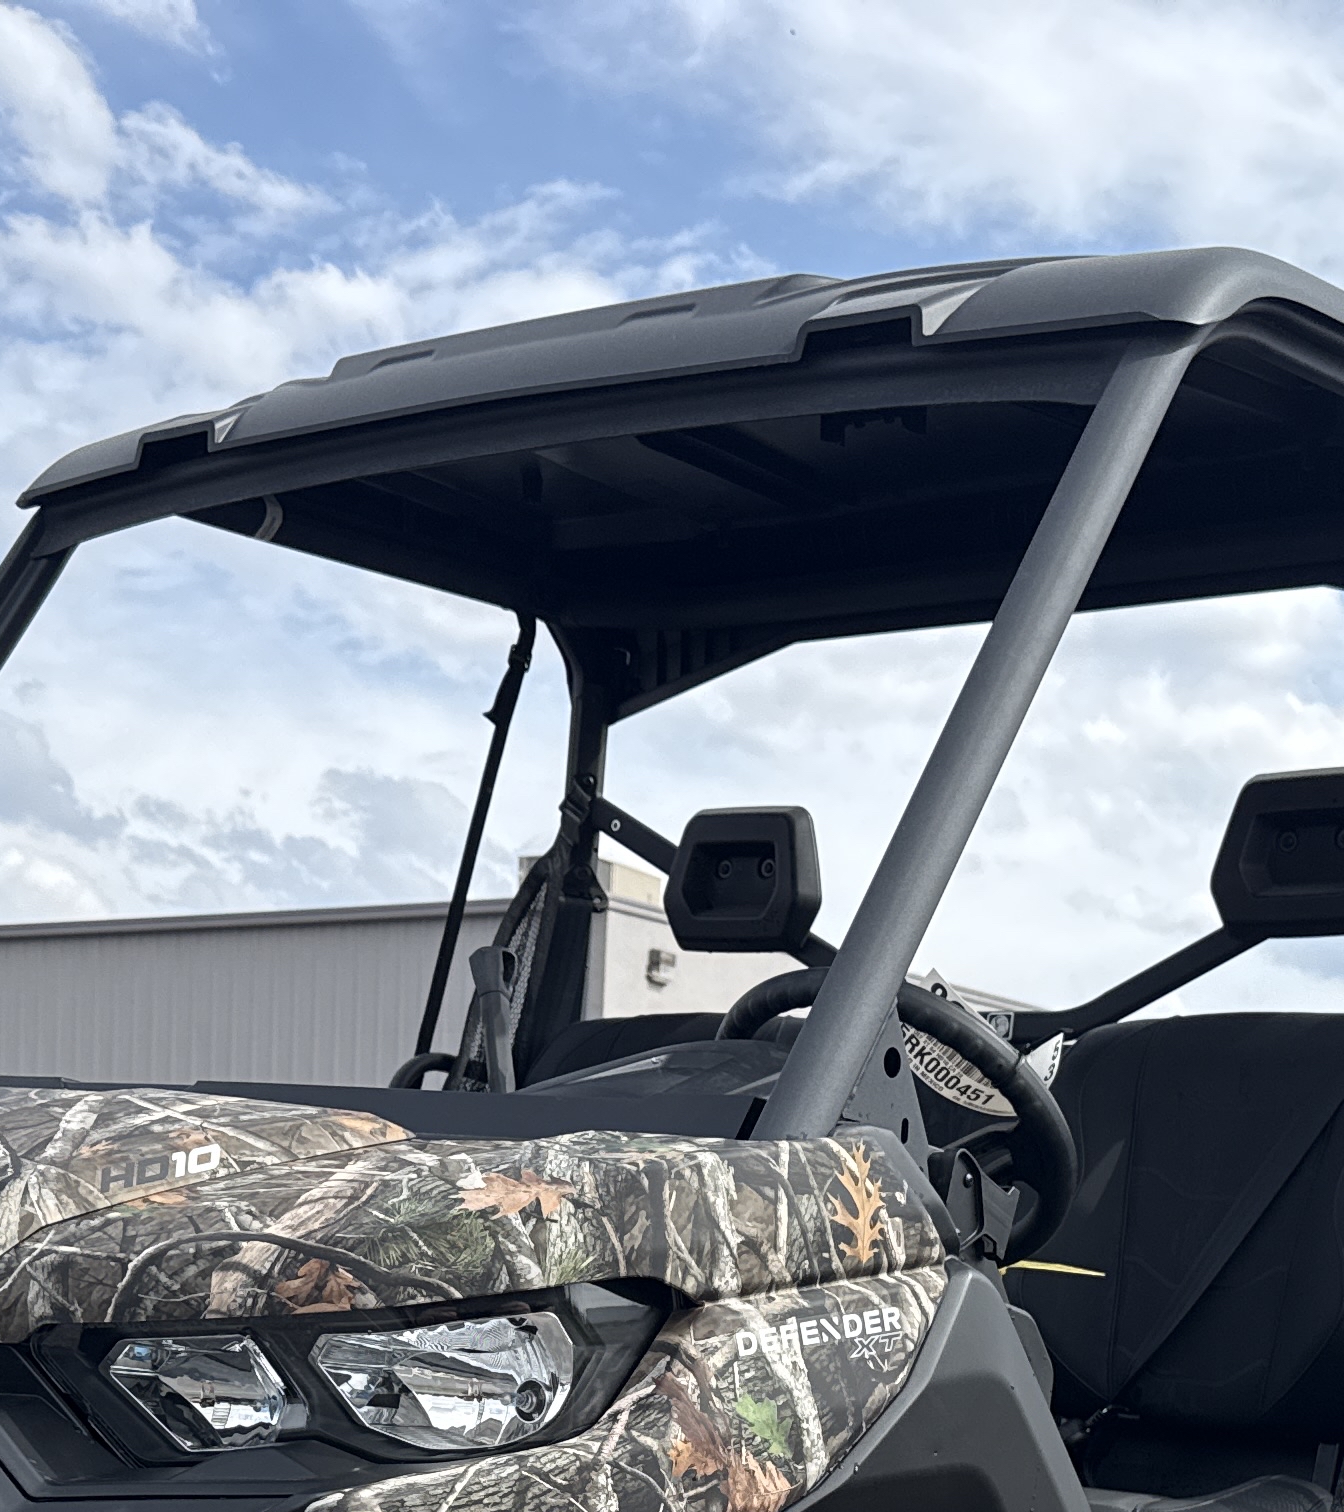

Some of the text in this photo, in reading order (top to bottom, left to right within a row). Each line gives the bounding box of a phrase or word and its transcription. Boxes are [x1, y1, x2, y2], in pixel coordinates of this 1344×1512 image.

[919, 1070, 944, 1092] MEXICO
[100, 1143, 221, 1193] HD10
[735, 1306, 902, 1357] DEFENDER
[850, 1331, 903, 1359] XT
